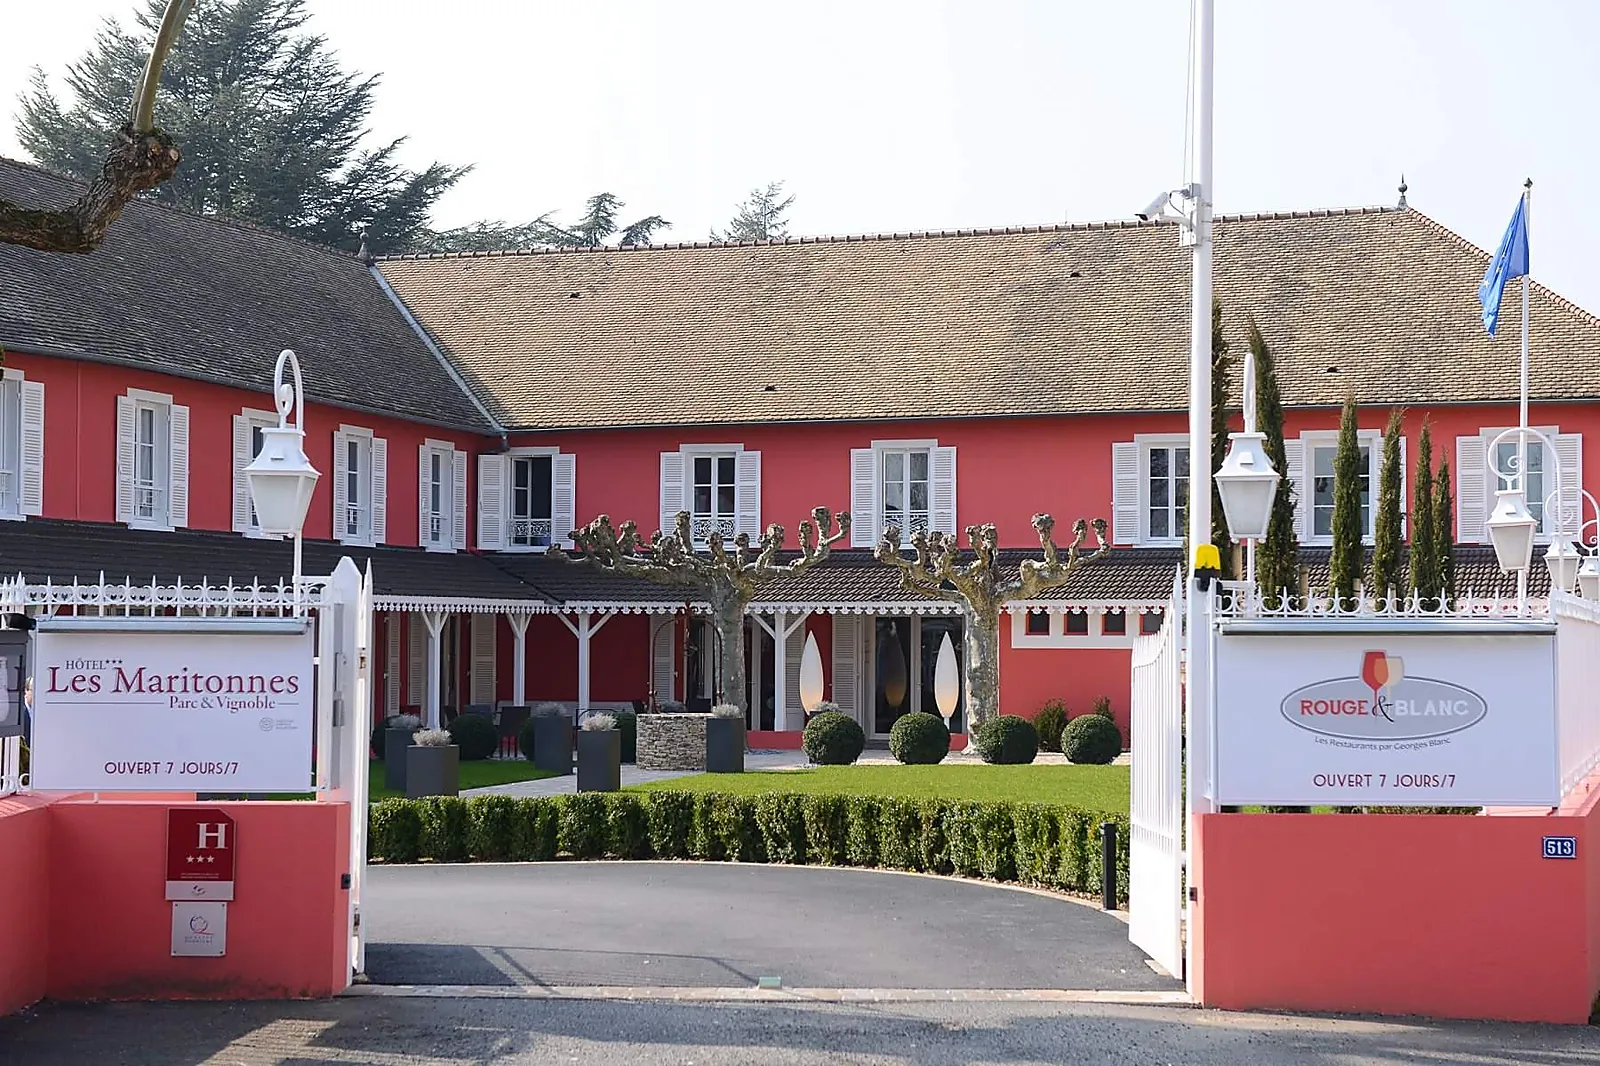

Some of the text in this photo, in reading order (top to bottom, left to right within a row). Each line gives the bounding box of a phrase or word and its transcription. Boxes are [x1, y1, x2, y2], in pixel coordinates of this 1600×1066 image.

[65, 657, 106, 670] HÔTEL
[46, 666, 299, 694] Les Maritonnes
[170, 695, 276, 714] Parc & Vignoble
[1301, 695, 1469, 722] ROUGE & BLANC
[1315, 736, 1452, 751] Les Restaurants par Georges Blanc
[104, 761, 239, 775] OUVERT 7 JOURS/7
[1313, 774, 1456, 788] OUVERT 7 JOURS/7
[196, 822, 229, 850] H
[1547, 840, 1572, 855] 513
